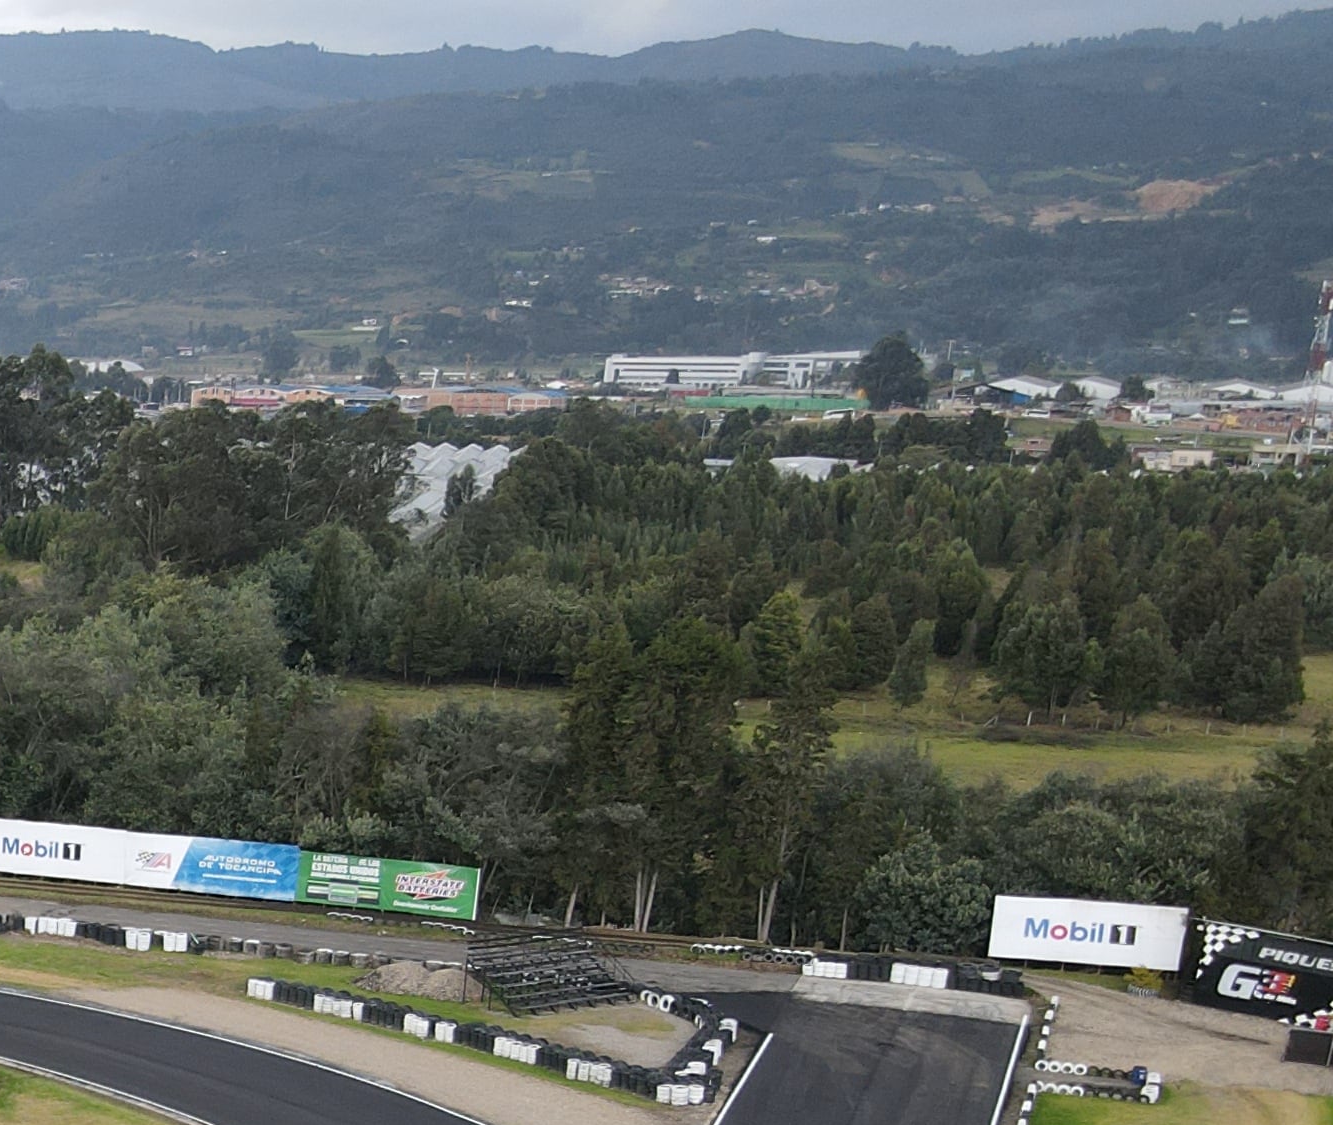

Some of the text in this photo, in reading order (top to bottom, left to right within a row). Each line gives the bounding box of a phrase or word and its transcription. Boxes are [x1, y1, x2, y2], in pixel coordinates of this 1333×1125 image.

[1, 836, 59, 859] Mobil
[203, 855, 276, 868] AUTODROMO
[395, 874, 465, 890] INTERSTATE
[396, 884, 459, 898] BATTERIES
[1023, 917, 1105, 943] Mobil
